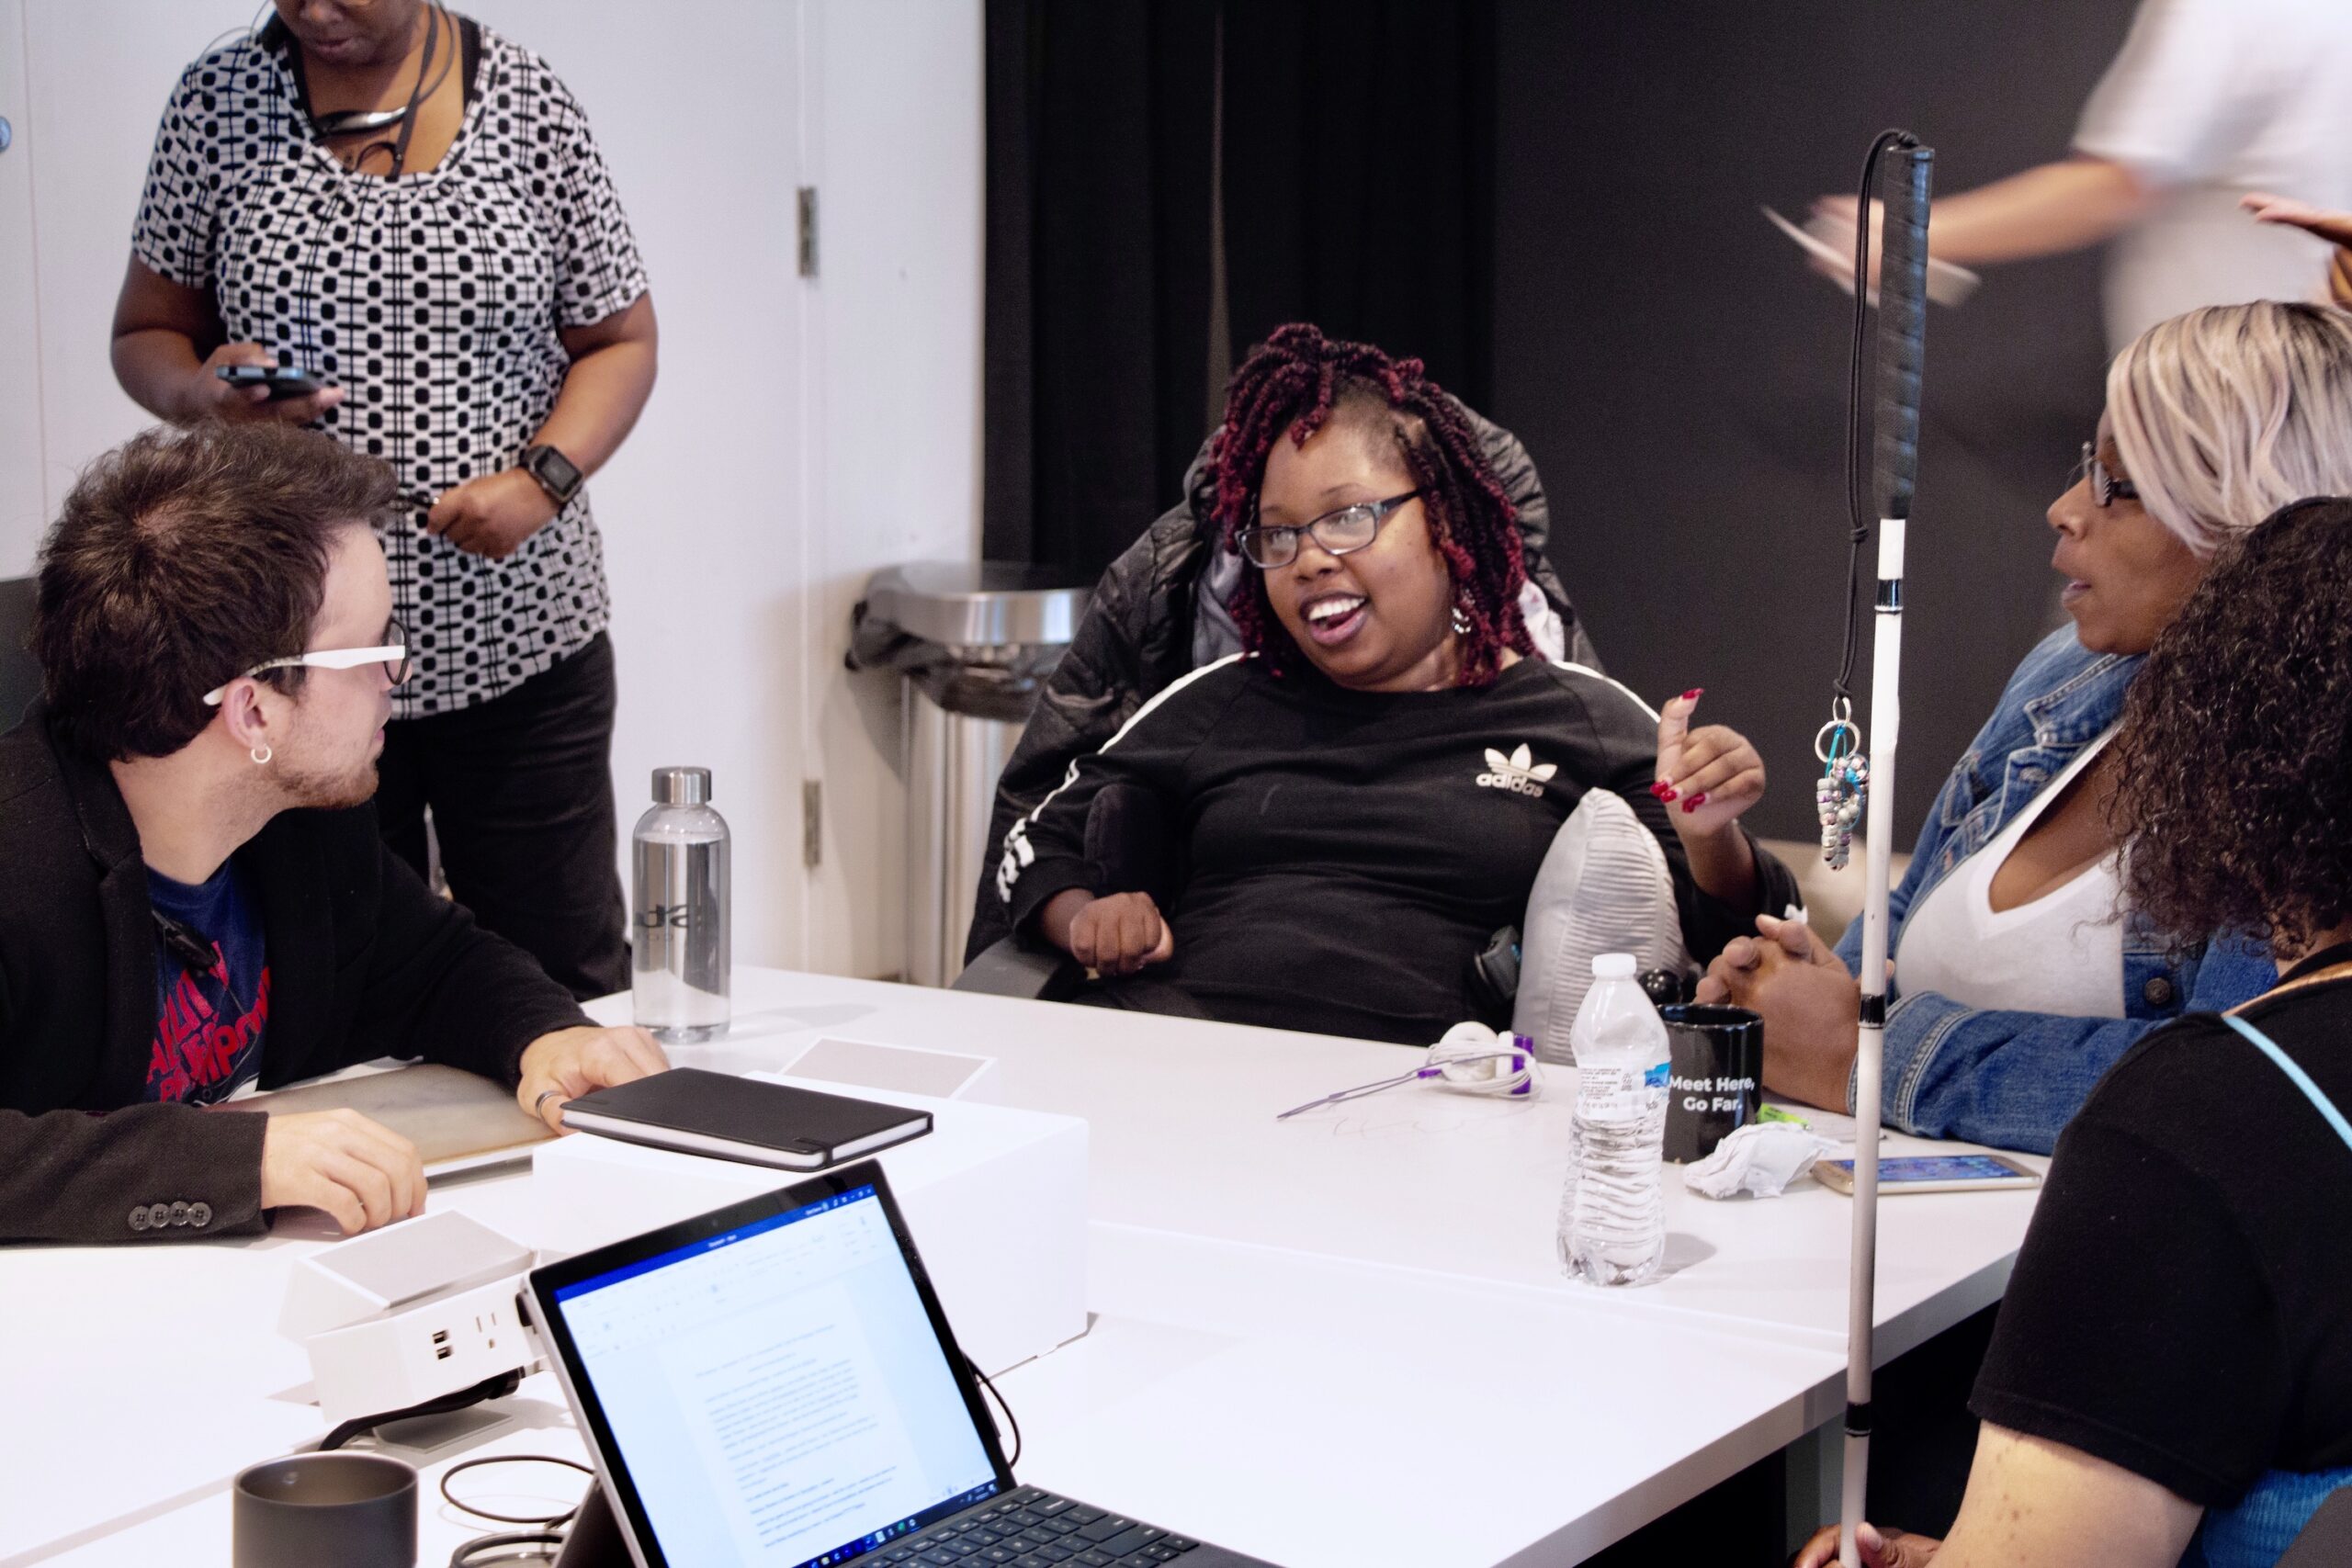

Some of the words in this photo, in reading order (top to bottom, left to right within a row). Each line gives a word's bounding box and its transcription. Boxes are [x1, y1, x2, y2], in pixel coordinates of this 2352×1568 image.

[1476, 773, 1544, 797] adidas
[1669, 1075, 1713, 1092] Meet
[1716, 1077, 1755, 1092] Here,
[1683, 1096, 1709, 1111] Go
